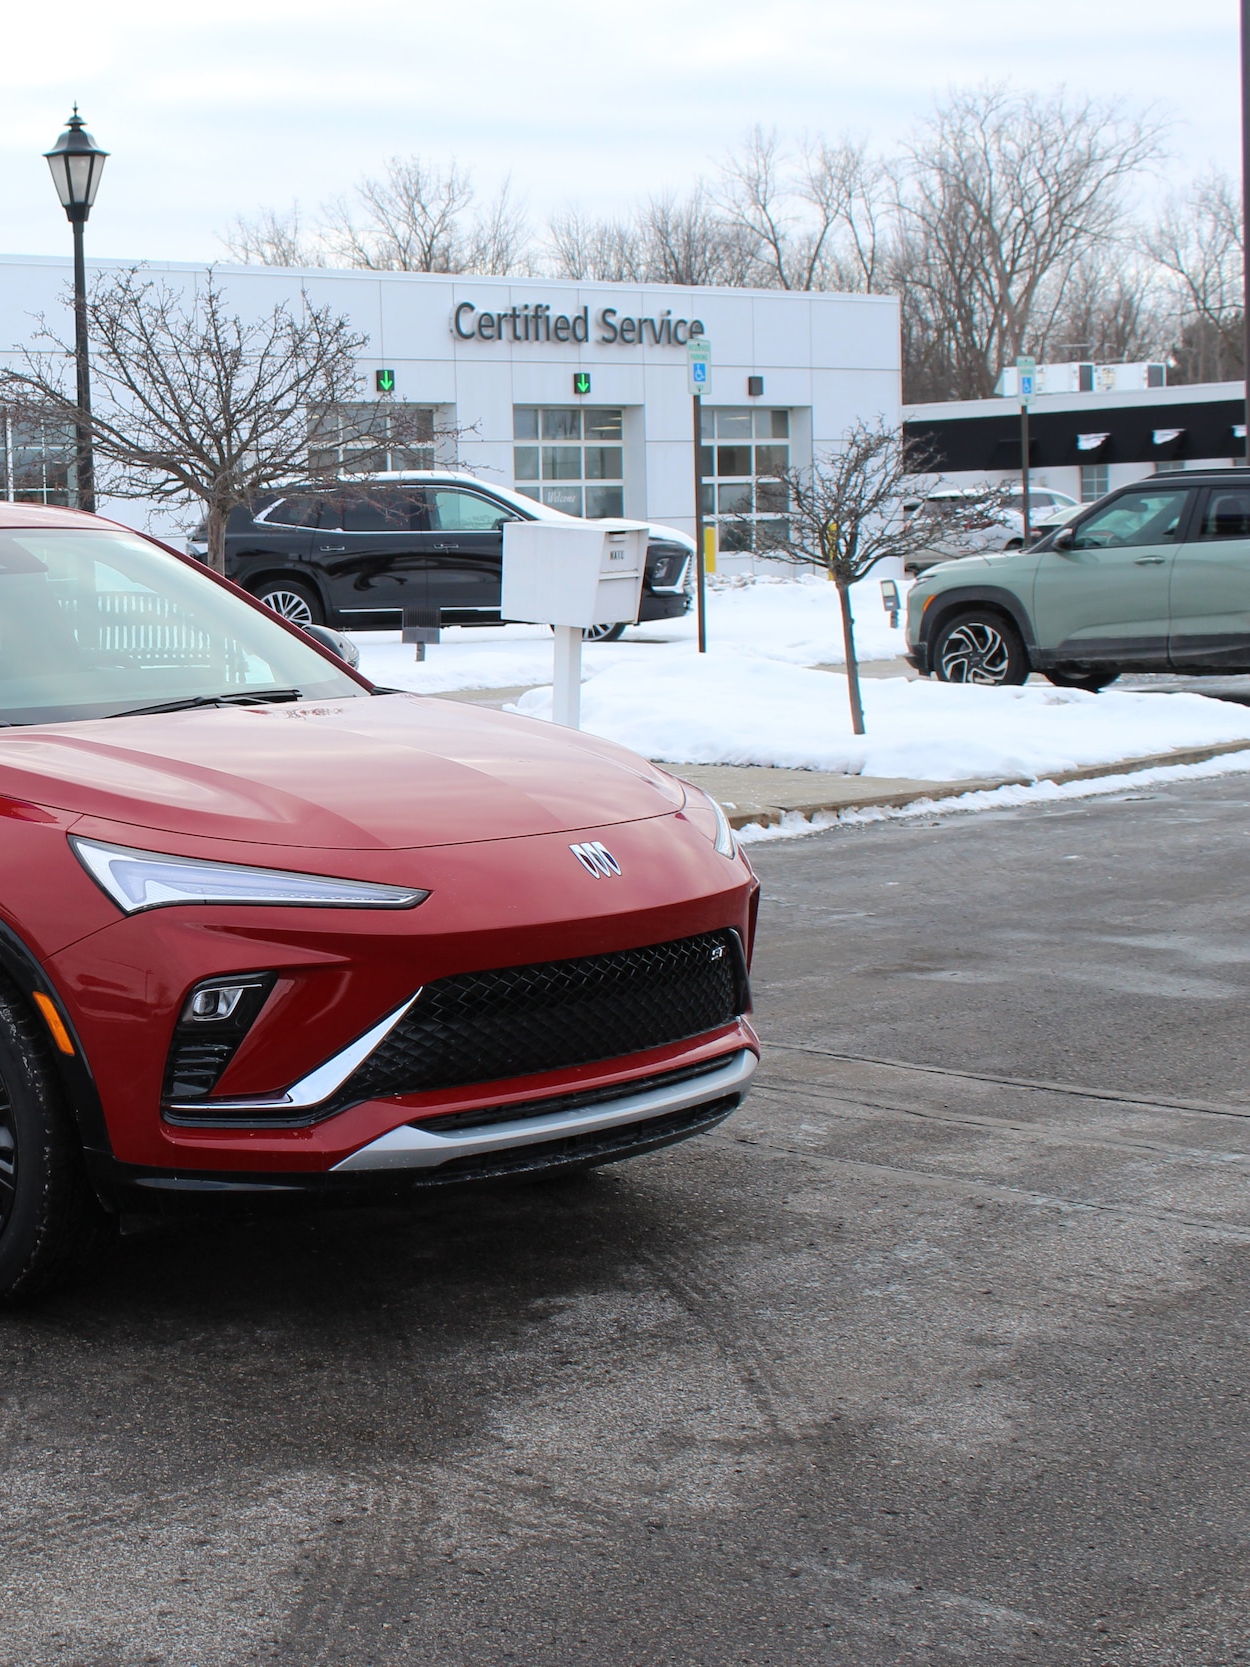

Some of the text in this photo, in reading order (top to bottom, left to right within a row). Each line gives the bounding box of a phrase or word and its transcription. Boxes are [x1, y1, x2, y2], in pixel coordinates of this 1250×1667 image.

[454, 301, 705, 345] Certified Service
[547, 491, 576, 503] Welcome
[710, 945, 726, 961] ST
